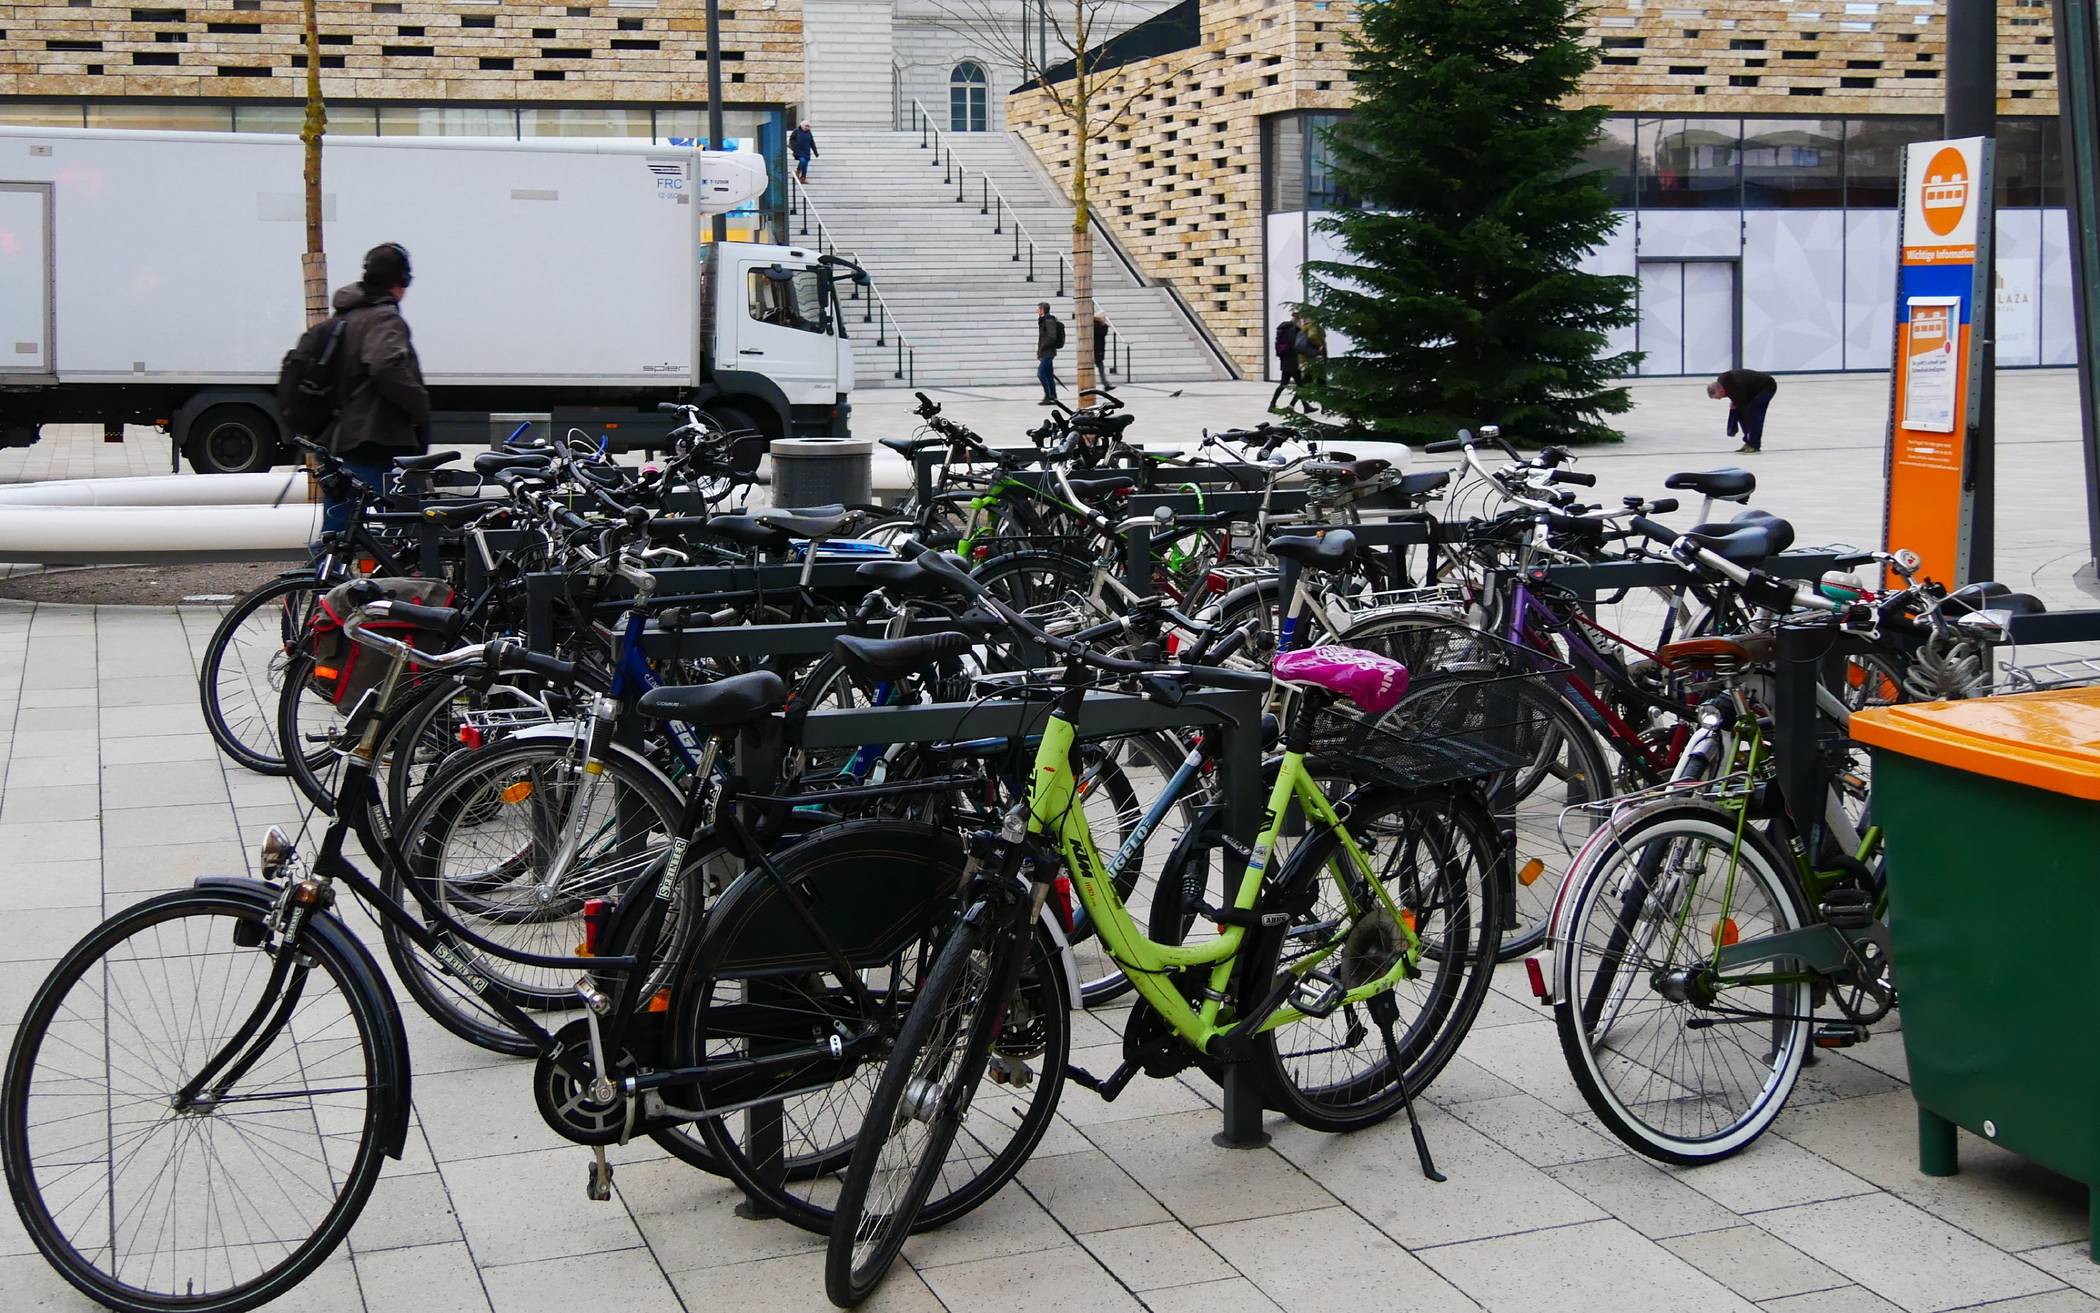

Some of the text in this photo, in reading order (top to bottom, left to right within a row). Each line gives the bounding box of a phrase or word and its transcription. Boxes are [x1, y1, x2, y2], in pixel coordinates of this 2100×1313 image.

[657, 178, 682, 189] FRC
[1906, 249, 1935, 262] Wichtige
[659, 841, 686, 897] SPRINTER
[1068, 838, 1094, 878] KTM
